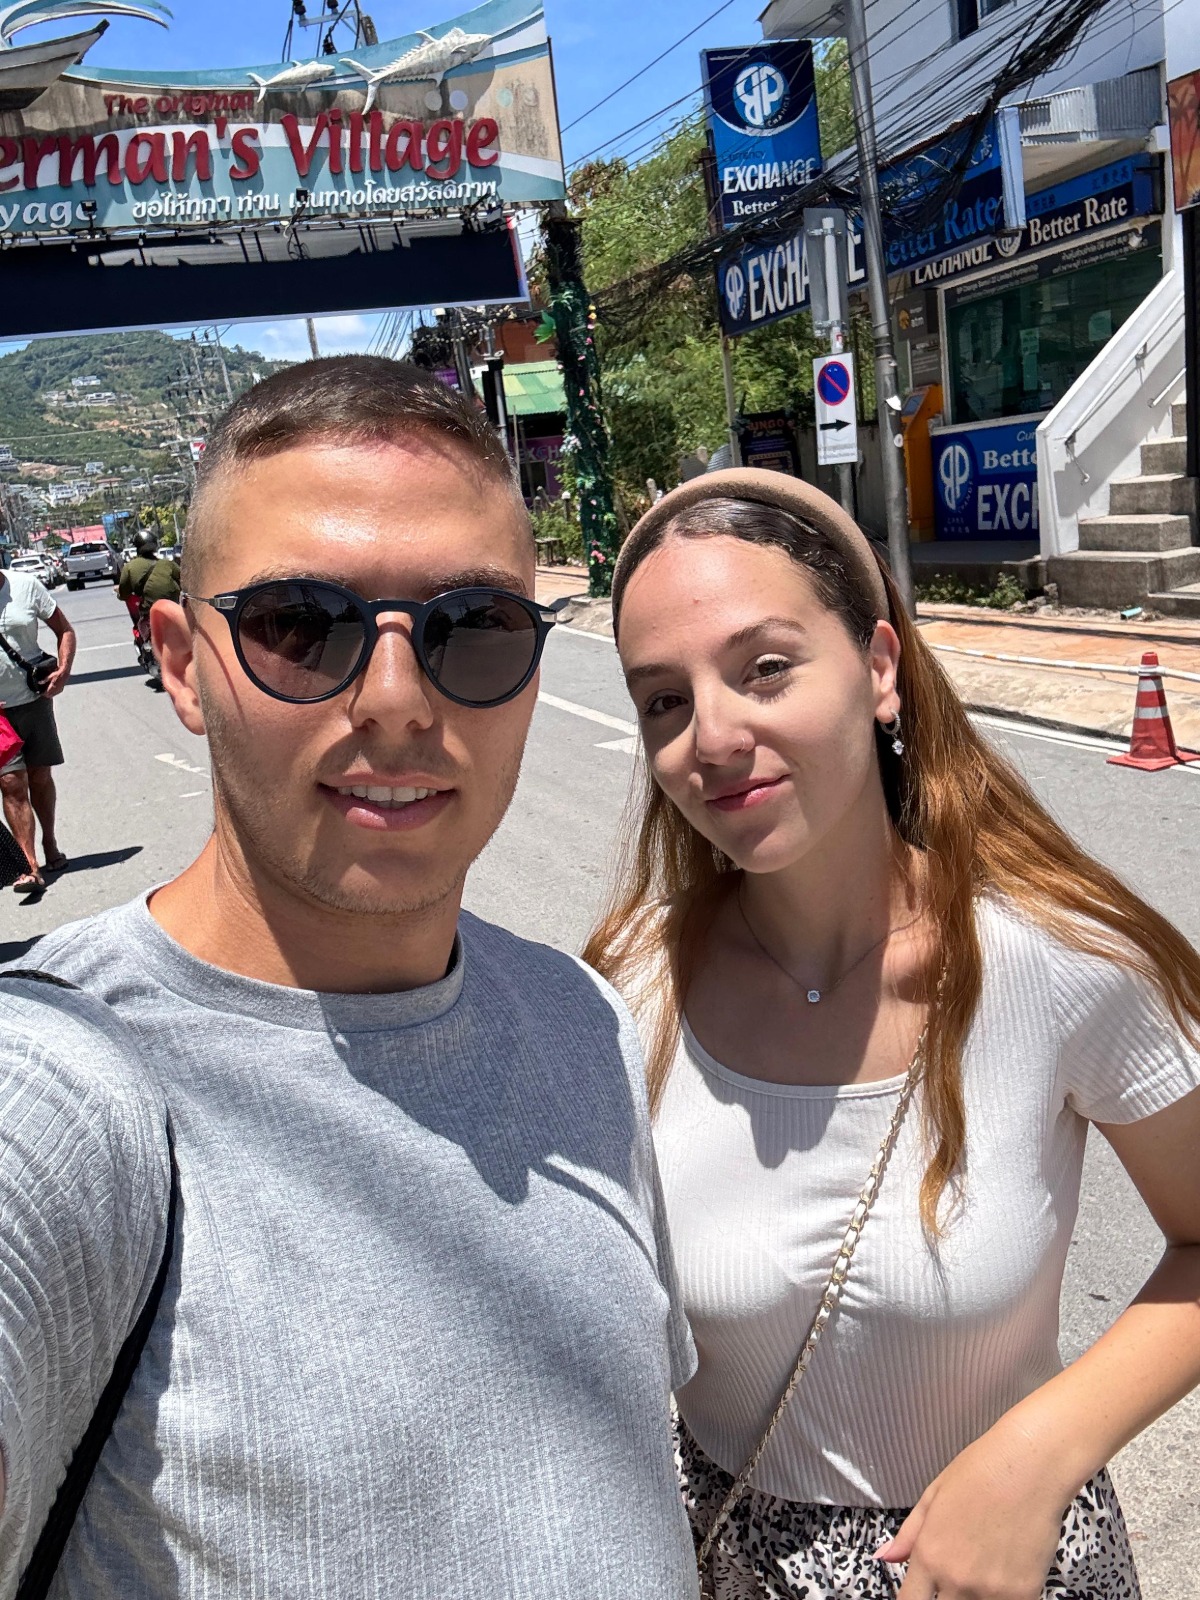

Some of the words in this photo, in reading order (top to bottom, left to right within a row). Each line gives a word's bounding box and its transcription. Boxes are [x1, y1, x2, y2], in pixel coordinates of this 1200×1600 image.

[104, 94, 149, 116] The
[156, 92, 254, 116] original
[280, 108, 499, 180] Village
[723, 158, 817, 194] EXCHANGE
[732, 199, 778, 217] Better
[942, 196, 999, 244] Rate
[1029, 212, 1081, 248] Better
[1084, 197, 1128, 228] Rate
